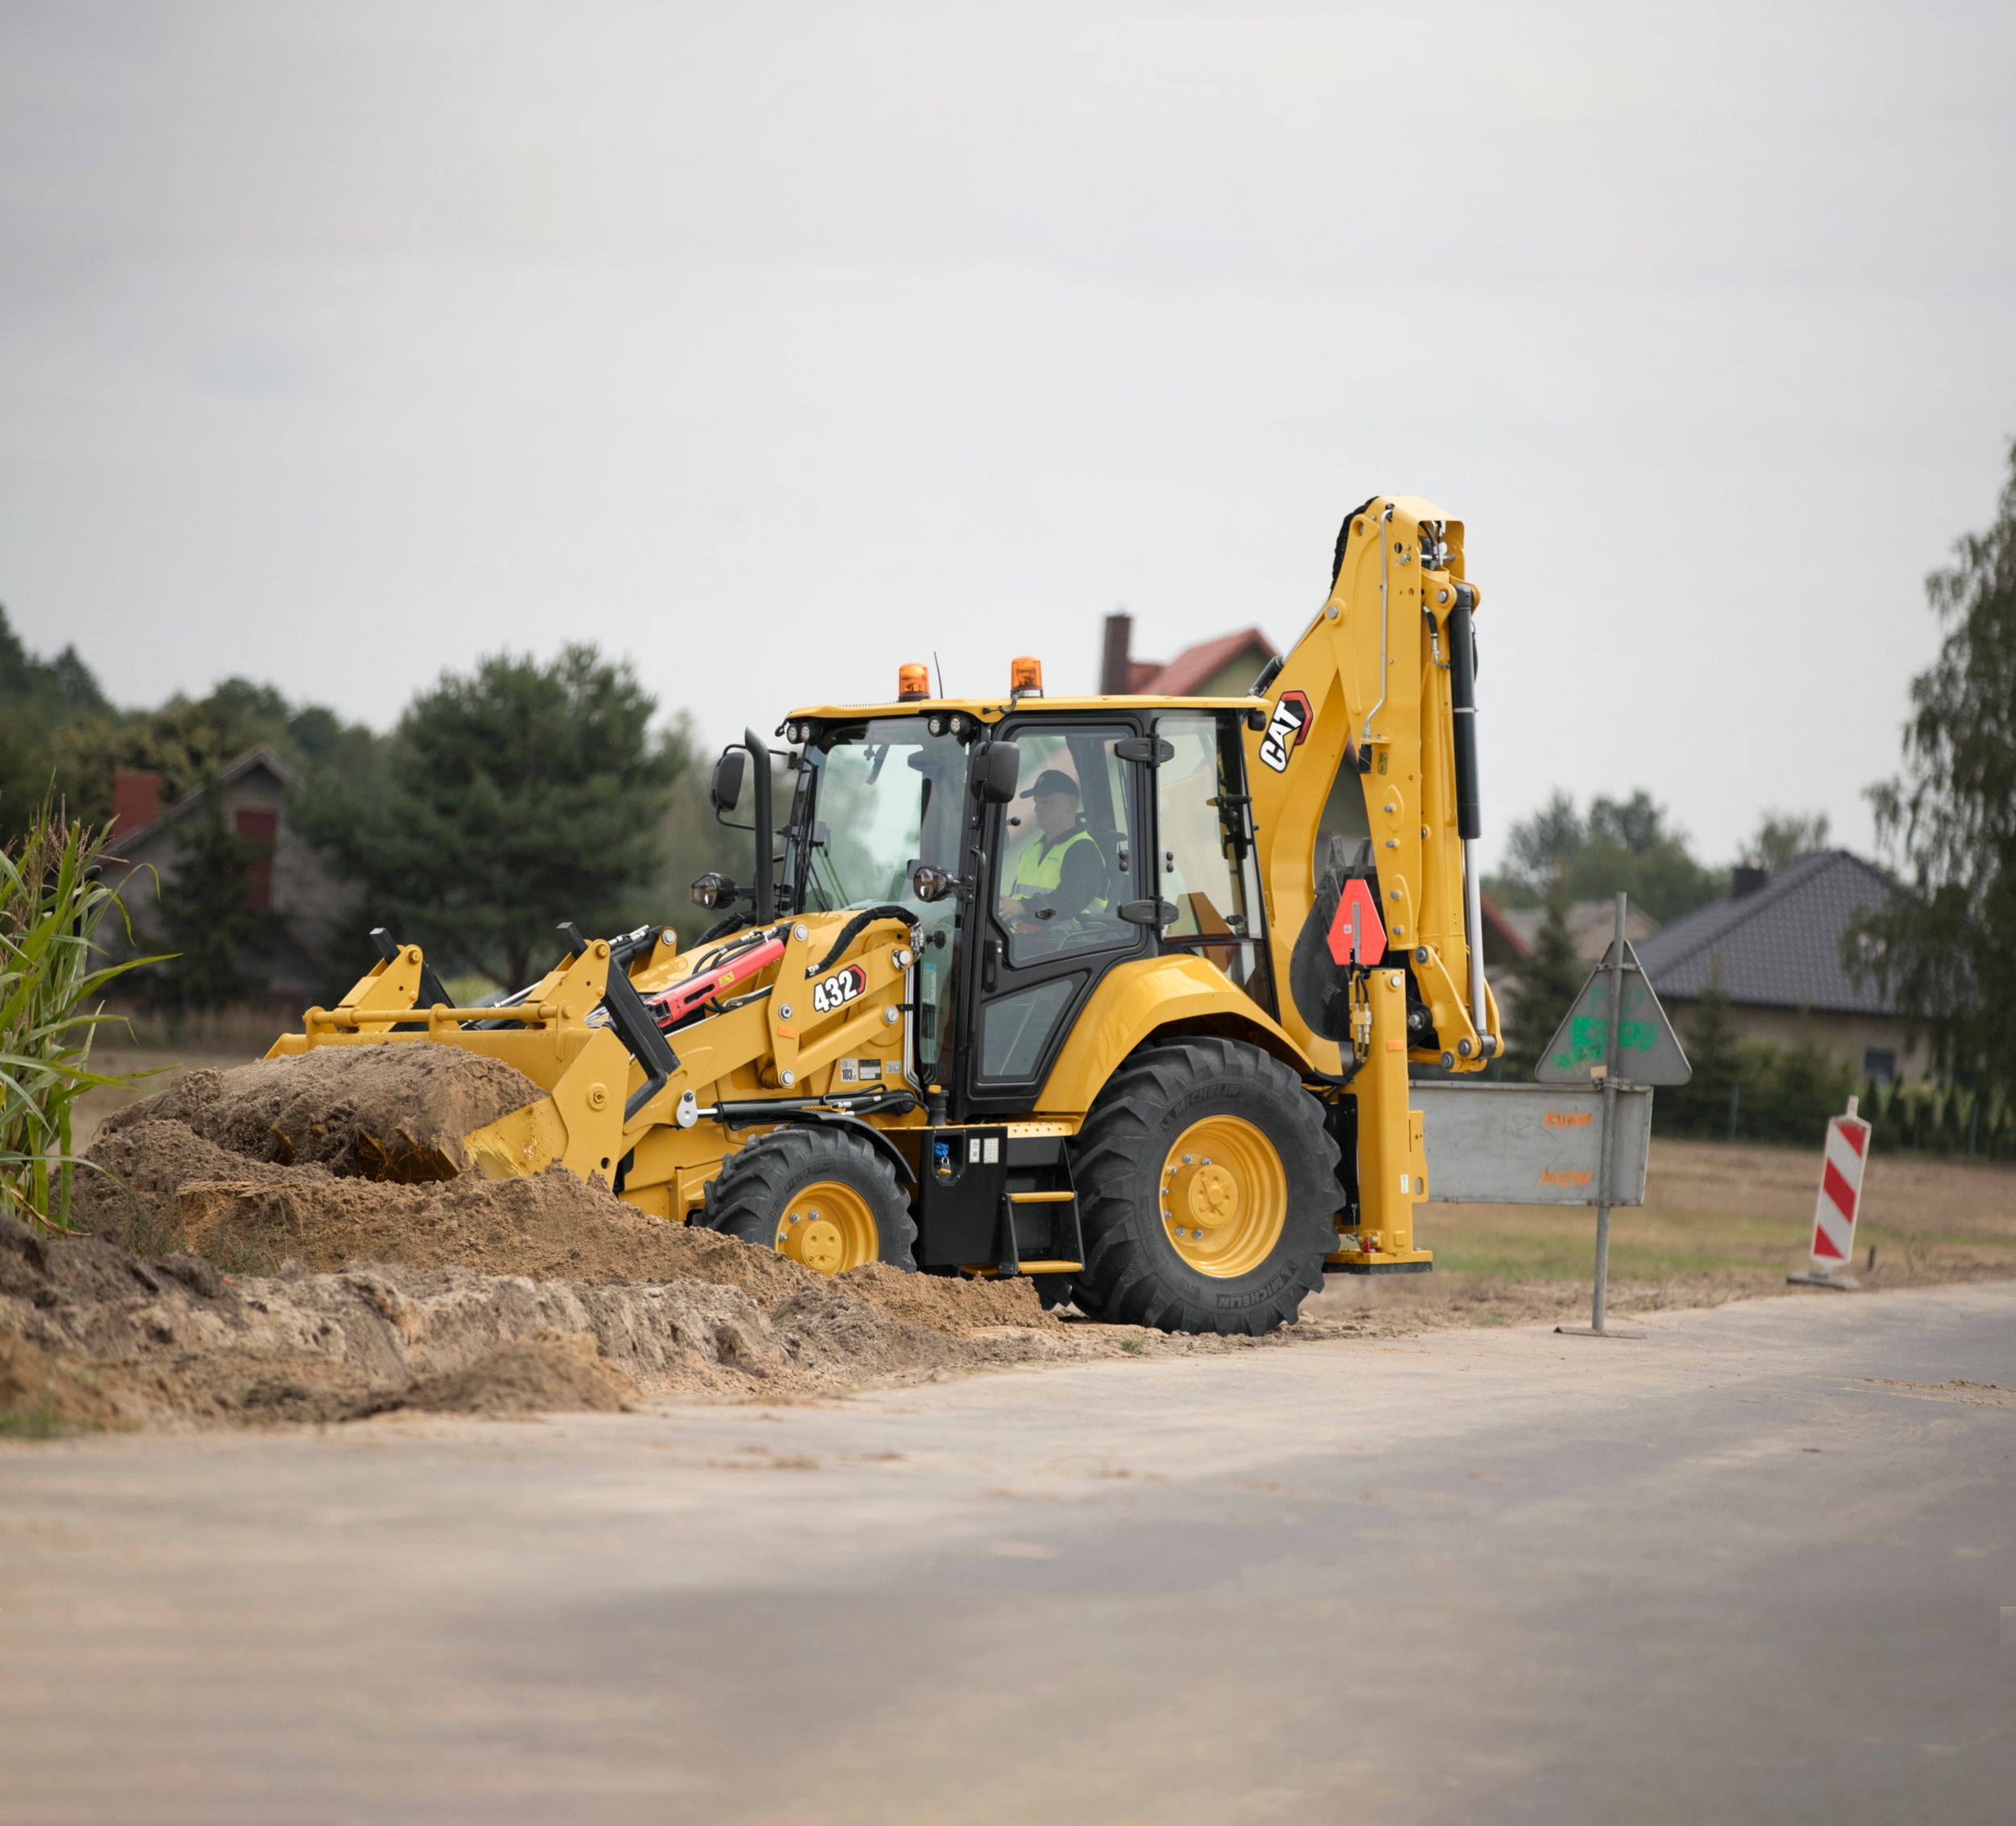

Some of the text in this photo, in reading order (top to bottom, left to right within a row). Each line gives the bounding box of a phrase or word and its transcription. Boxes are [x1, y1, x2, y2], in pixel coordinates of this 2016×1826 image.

[1260, 699, 1302, 772] CAT
[814, 969, 858, 1011] 432
[842, 1069, 852, 1080] 103
[1174, 1084, 1242, 1116] MICHELIN
[1218, 1274, 1285, 1308] MICHELIN
